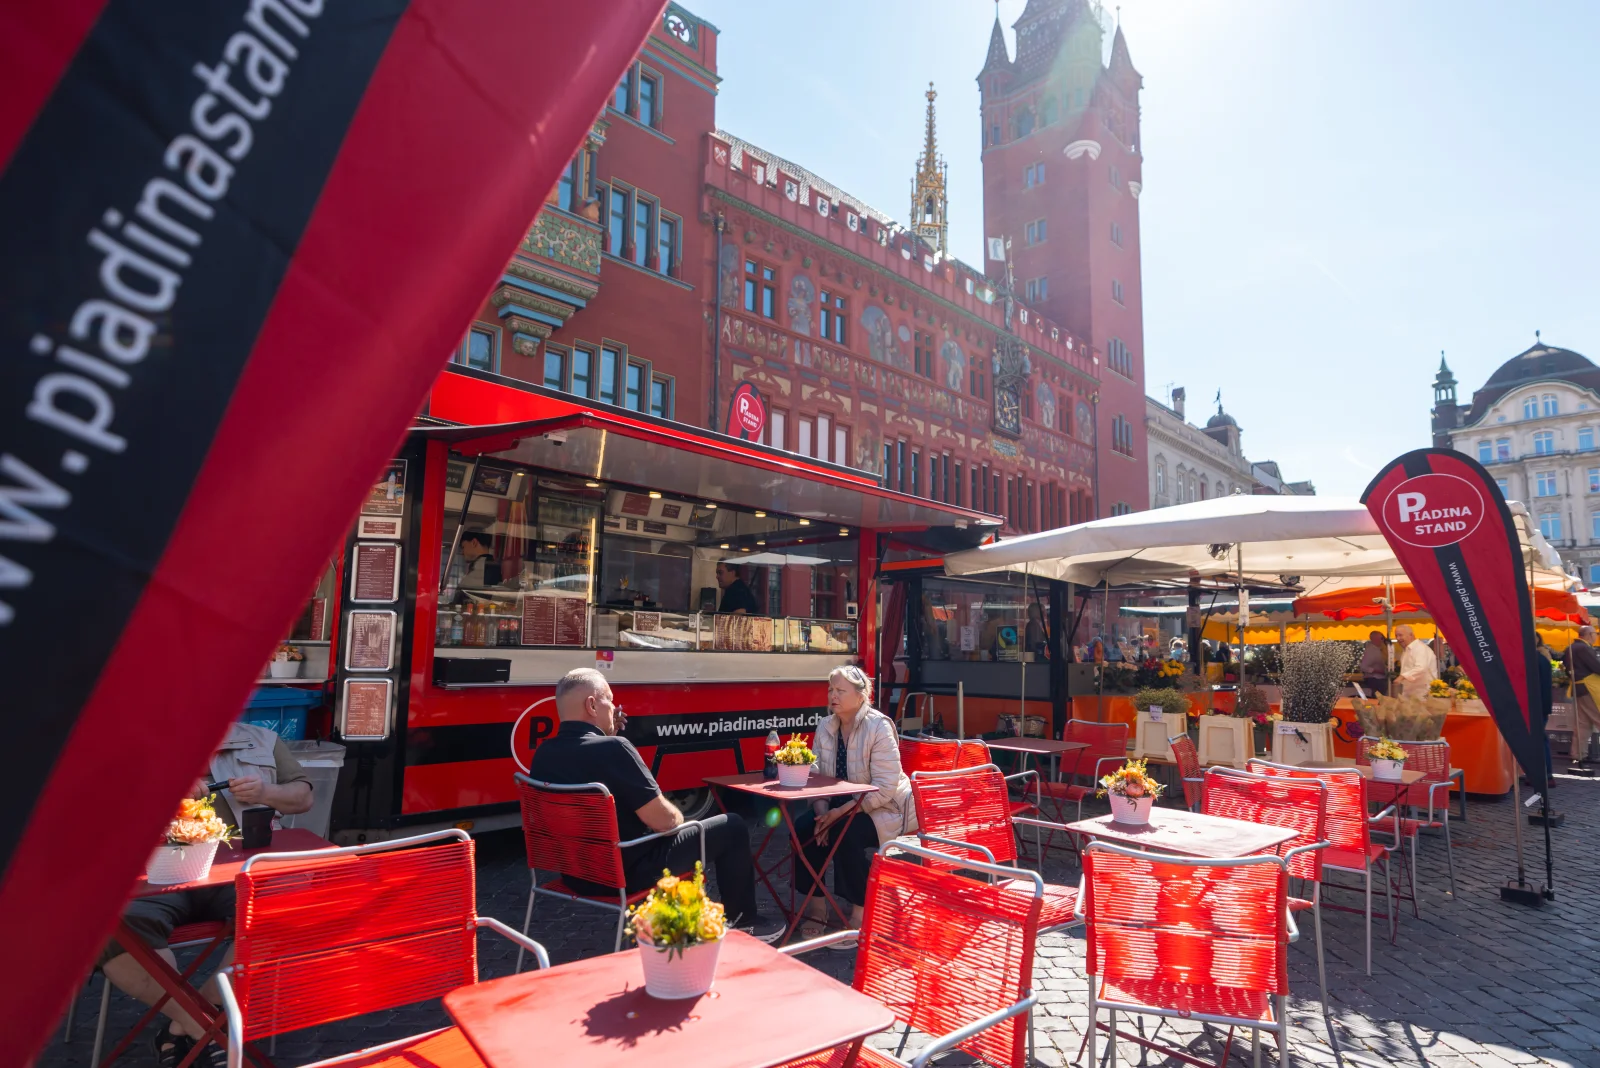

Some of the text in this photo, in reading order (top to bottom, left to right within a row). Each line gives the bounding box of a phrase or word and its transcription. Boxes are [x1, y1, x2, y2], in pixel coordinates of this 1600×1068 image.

[743, 416, 758, 428] STAND
[1397, 492, 1472, 523] PIADINA
[1415, 521, 1467, 535] STAND
[1448, 562, 1494, 663] www.piadinastand.ch
